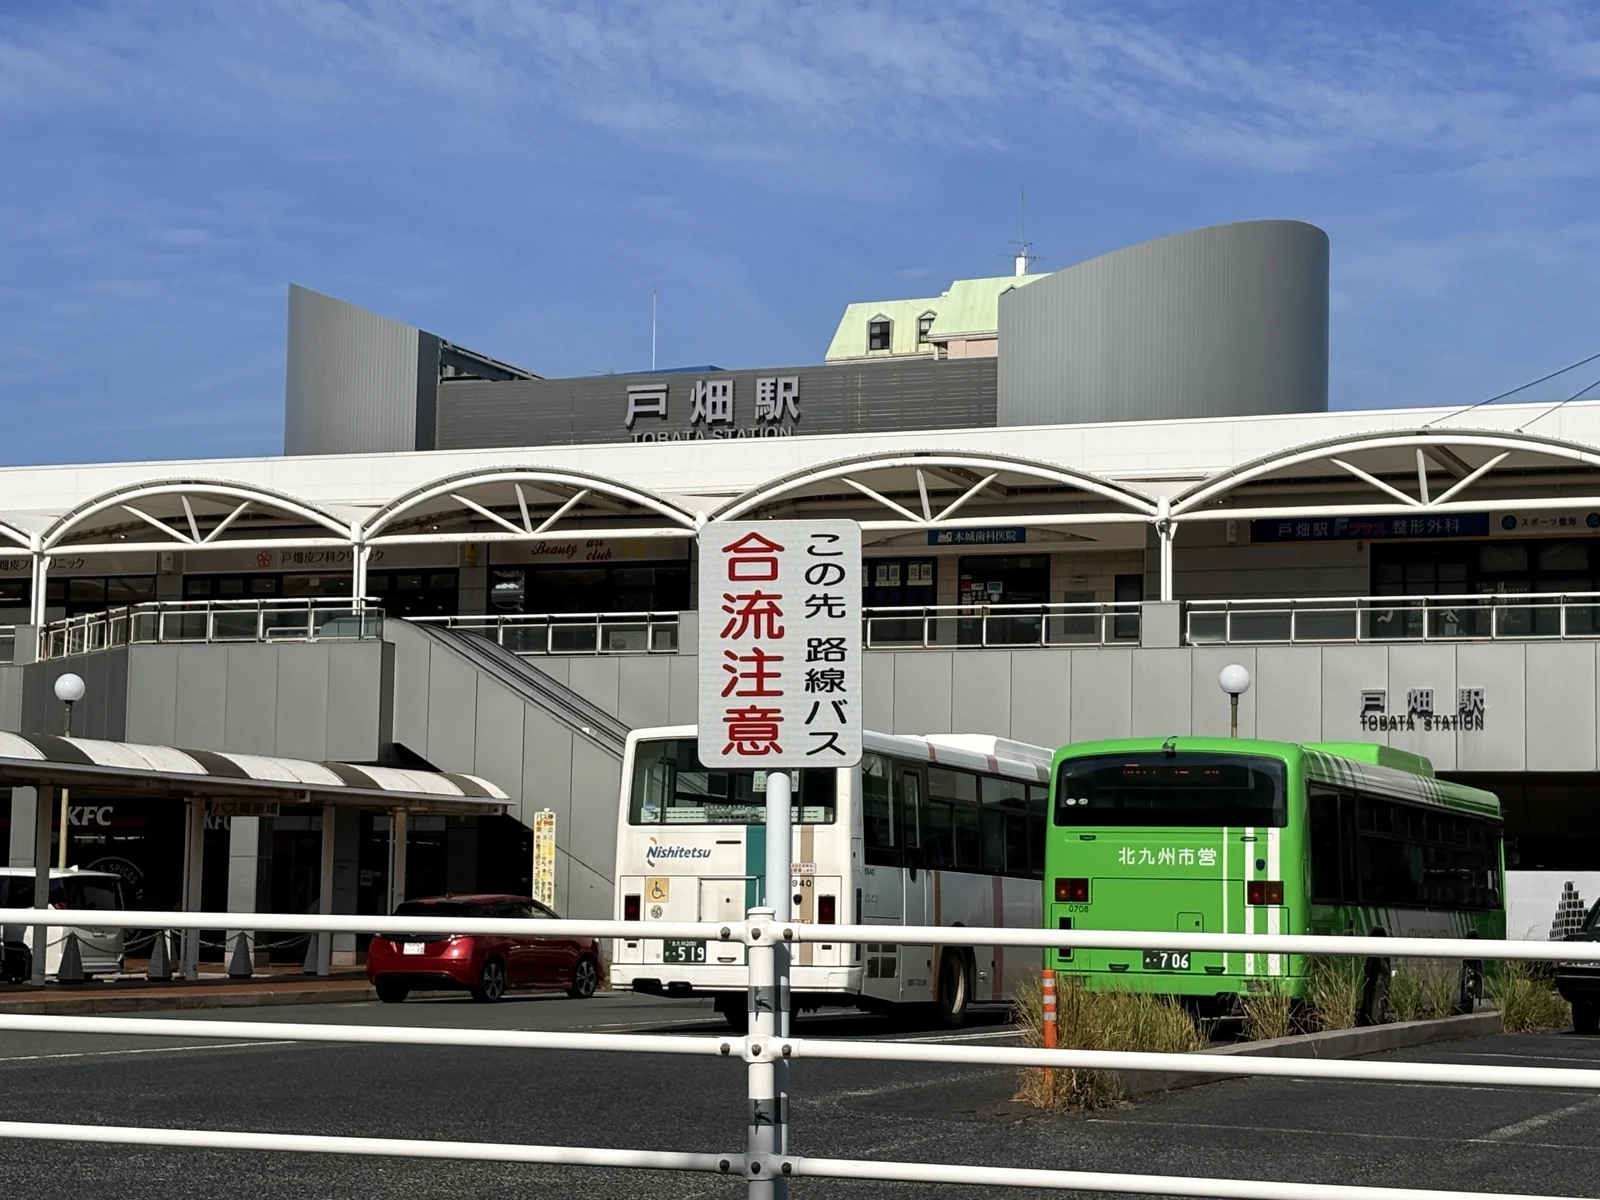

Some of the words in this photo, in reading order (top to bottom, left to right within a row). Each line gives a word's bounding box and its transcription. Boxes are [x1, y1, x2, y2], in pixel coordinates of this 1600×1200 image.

[624, 376, 800, 427] 戸畑駅
[631, 431, 704, 444] TOBATA
[712, 426, 792, 440] STATION
[1278, 522, 1328, 537] 戸畑駅
[1392, 517, 1460, 534] 整形外科
[531, 541, 578, 559] Beauty
[586, 548, 612, 561] club
[804, 533, 846, 619] この先
[720, 532, 785, 756] 合流注意
[804, 637, 848, 756] 路線バス
[1360, 688, 1485, 715] 戸畑駅
[1360, 715, 1415, 729] TOBATA
[1424, 714, 1485, 729] STATION
[67, 805, 113, 826] KFC
[647, 846, 711, 859] Nishitetsu
[1118, 846, 1217, 867] 北九州市営
